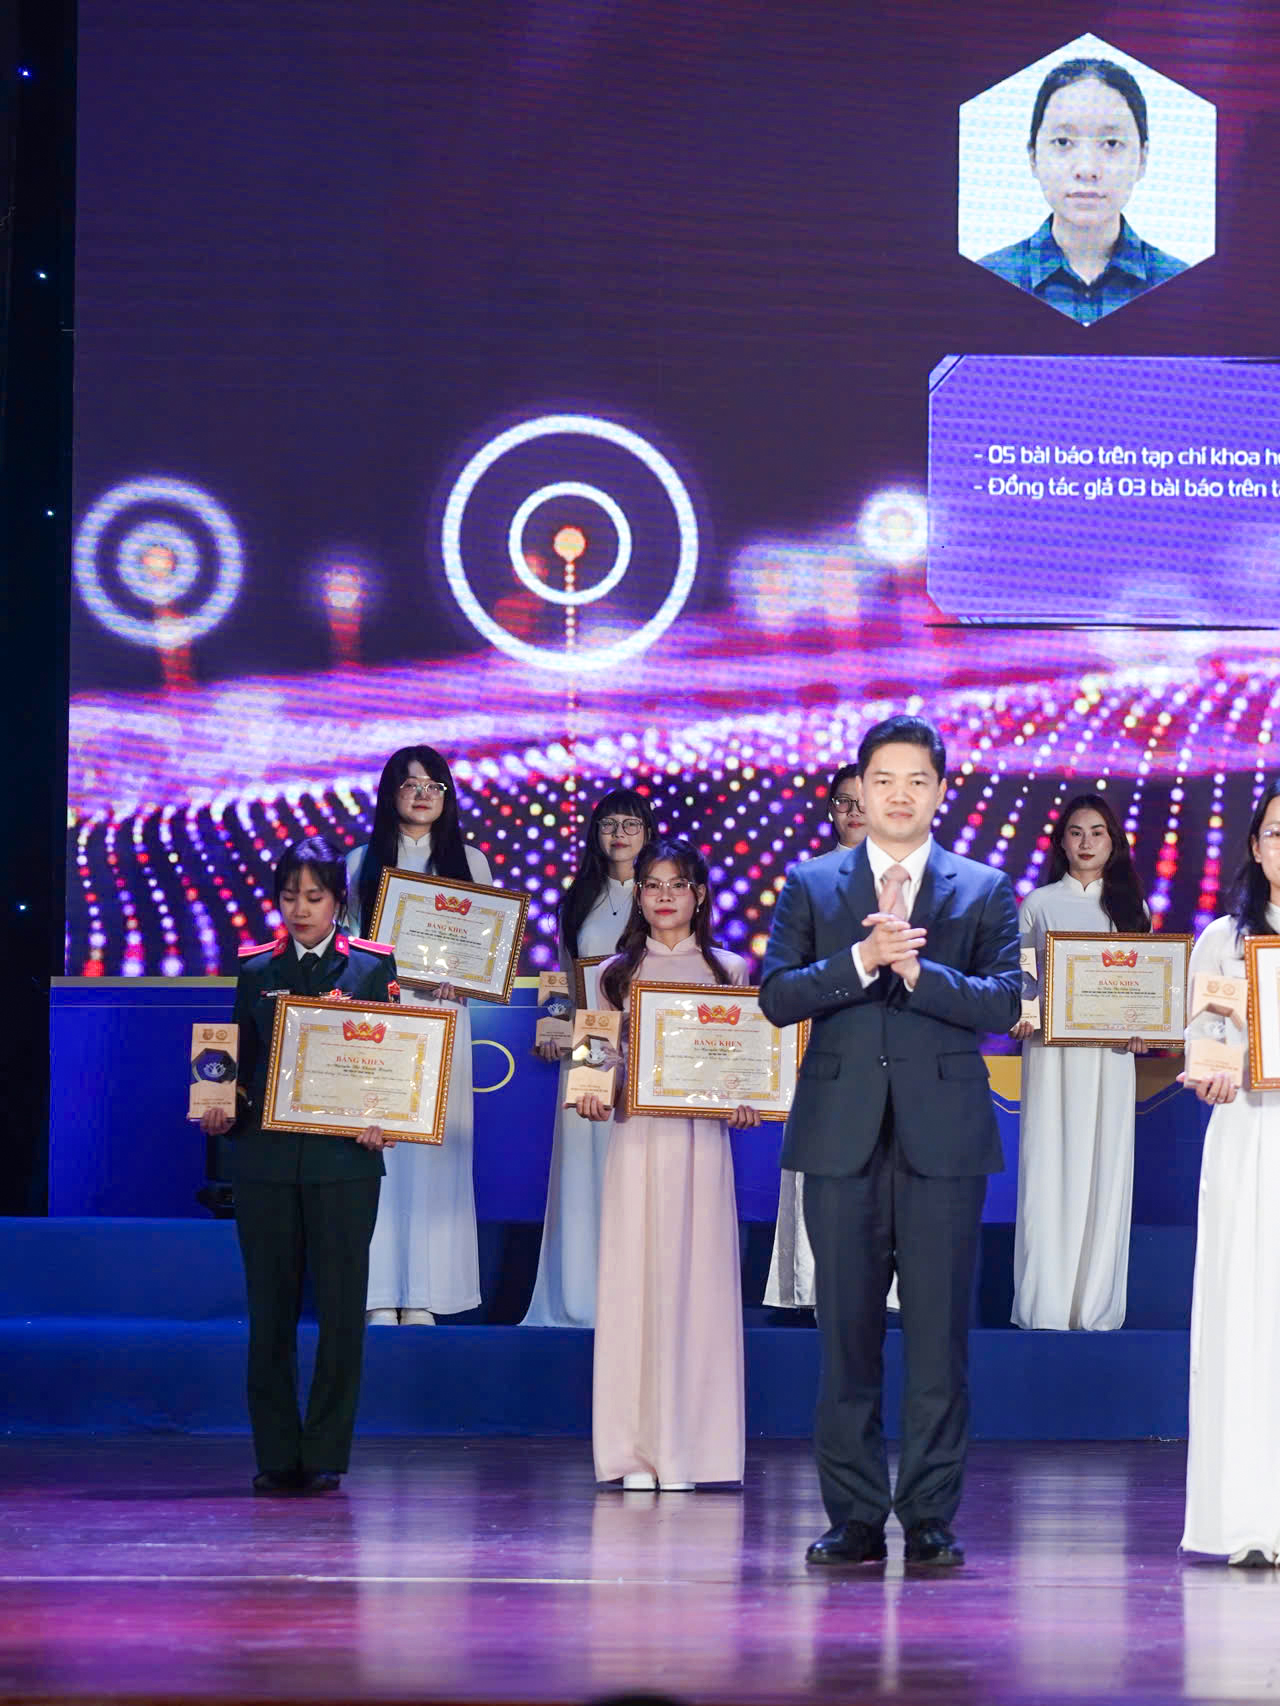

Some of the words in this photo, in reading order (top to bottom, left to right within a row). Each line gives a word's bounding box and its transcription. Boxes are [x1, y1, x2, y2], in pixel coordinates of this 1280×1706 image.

[988, 444, 1016, 464] 05
[1054, 445, 1094, 465] báo
[1098, 445, 1137, 465] trên
[1141, 446, 1174, 469] tạp
[1177, 446, 1207, 465] chí
[1210, 447, 1261, 466] khoa
[1048, 476, 1080, 496] tác
[1118, 477, 1146, 497] 03
[1184, 477, 1224, 497] báo
[1227, 477, 1267, 497] trên
